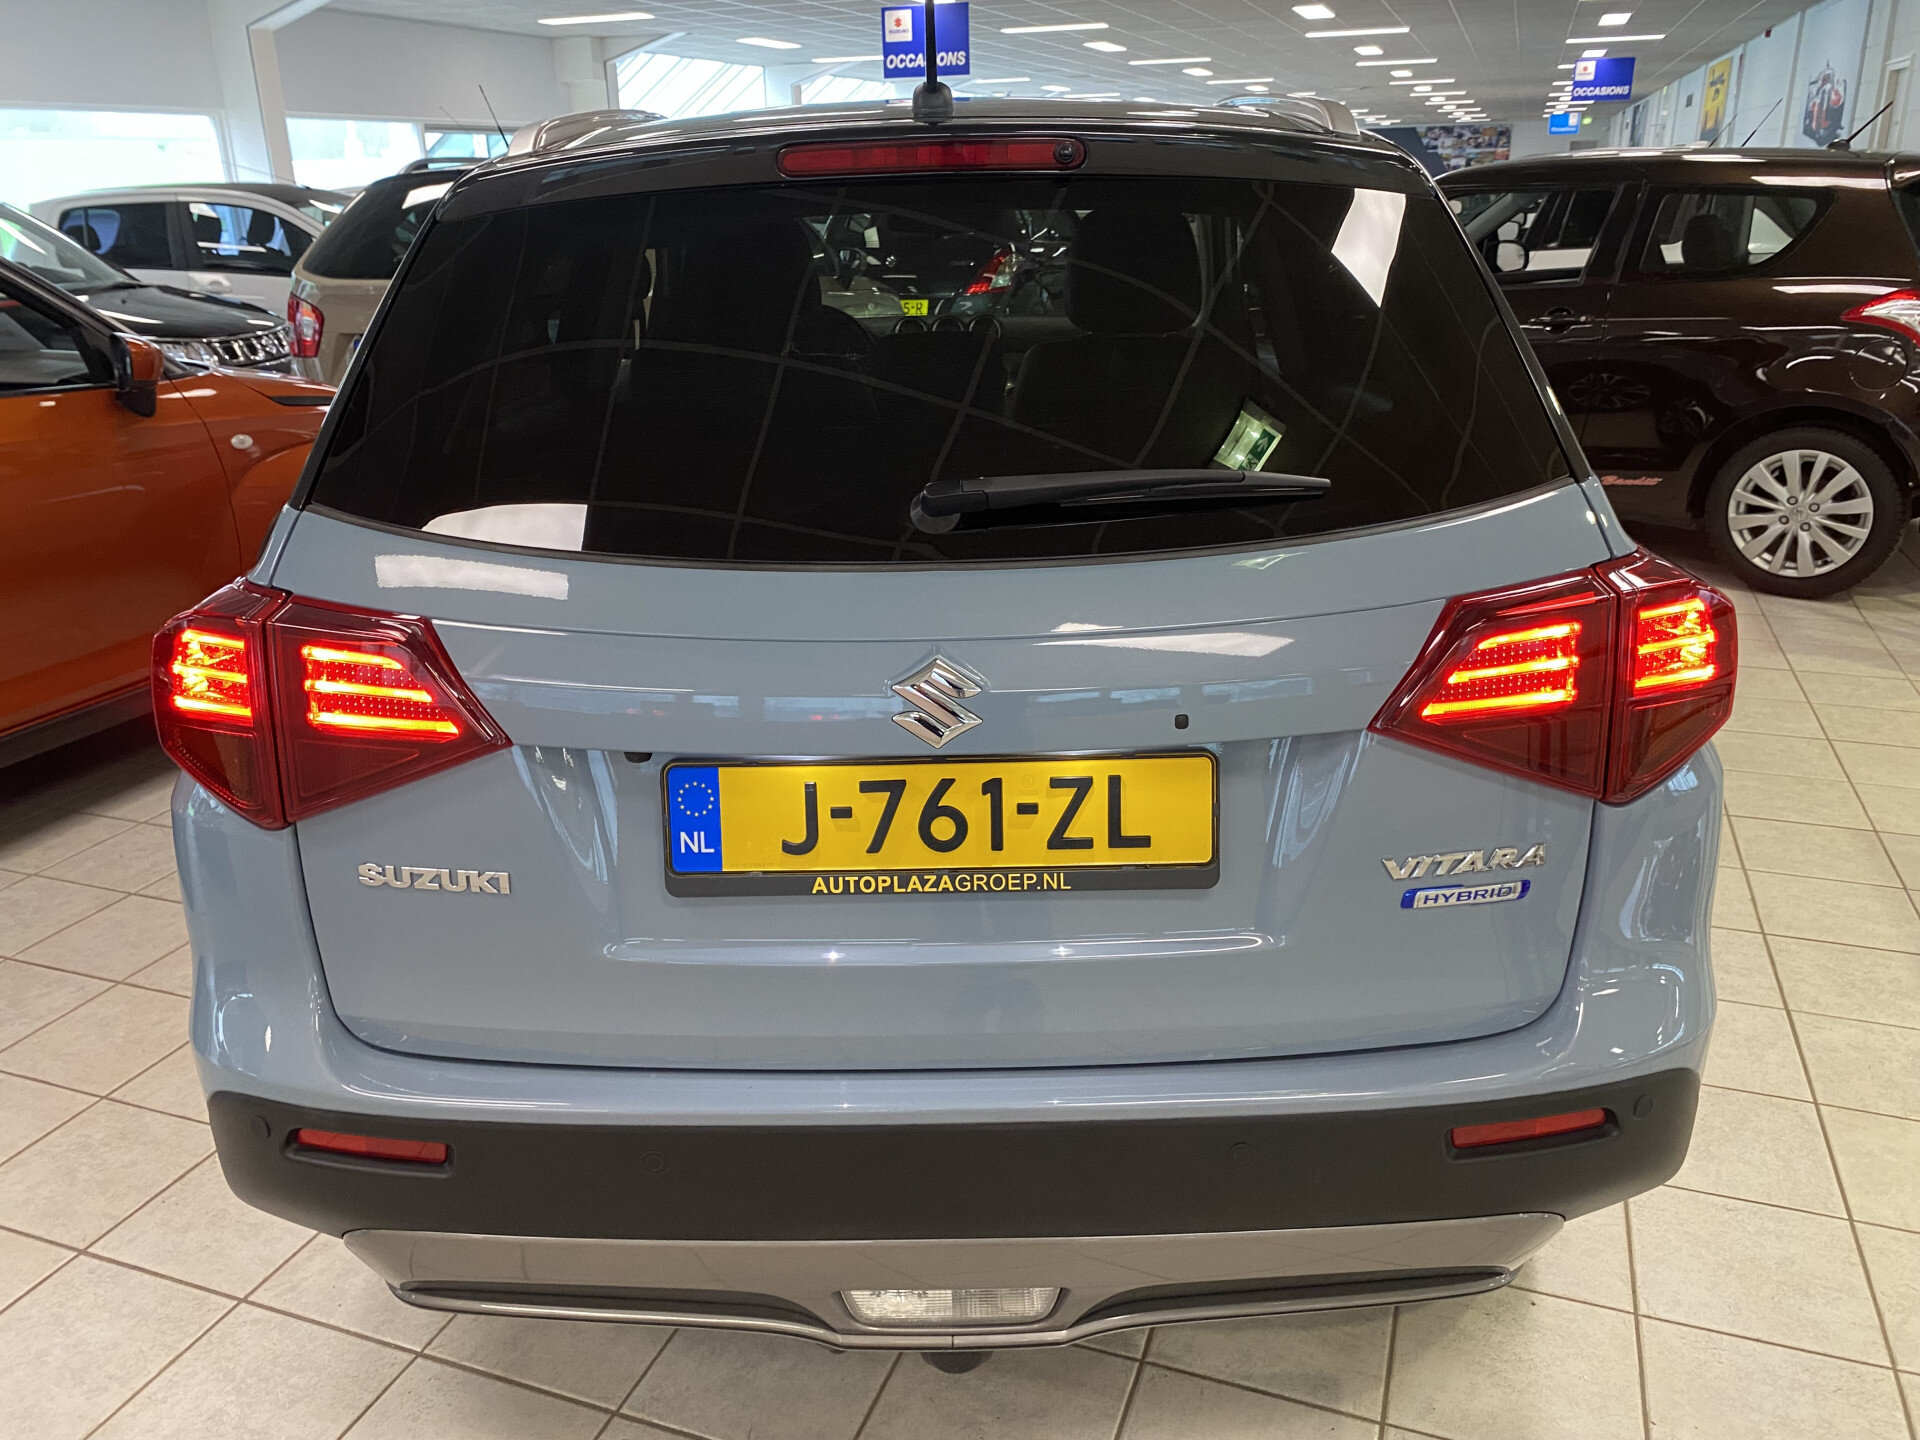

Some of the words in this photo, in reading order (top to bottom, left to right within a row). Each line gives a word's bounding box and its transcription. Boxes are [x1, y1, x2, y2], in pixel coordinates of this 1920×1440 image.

[886, 51, 966, 69] OCCAONS
[1573, 85, 1629, 97] OCCASIONS
[781, 775, 1152, 856] J-761-ZL
[680, 831, 715, 853] NL
[1382, 843, 1546, 880] VITARA
[358, 863, 510, 894] SUZUKI
[811, 873, 1072, 894] AUTOPLAZAGROEP.NL
[1423, 886, 1513, 905] HYBRID
